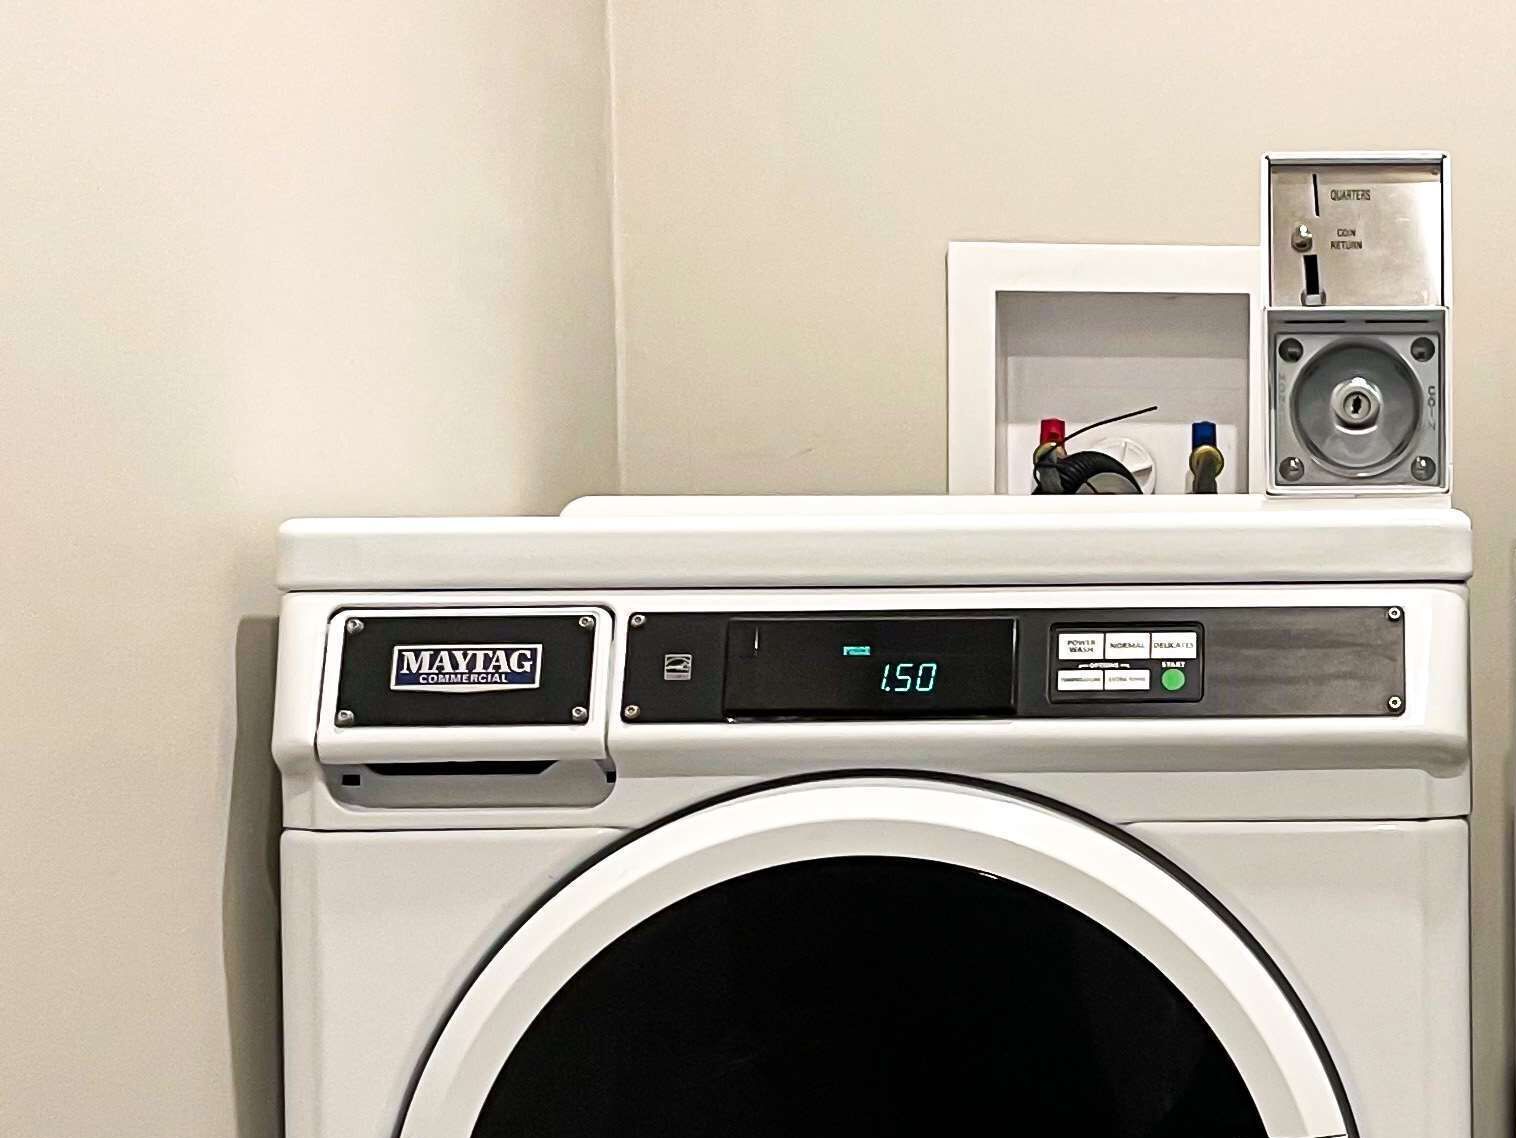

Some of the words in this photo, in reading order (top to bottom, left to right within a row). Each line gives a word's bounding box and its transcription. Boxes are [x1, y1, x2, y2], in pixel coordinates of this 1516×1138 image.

[1330, 189, 1371, 201] QUARTERS
[1336, 229, 1356, 237] COIN
[1330, 240, 1363, 249] RETURN
[400, 650, 533, 674] MAYTAG
[419, 673, 508, 684] COMMERCIAL
[881, 663, 937, 692] 1.50
